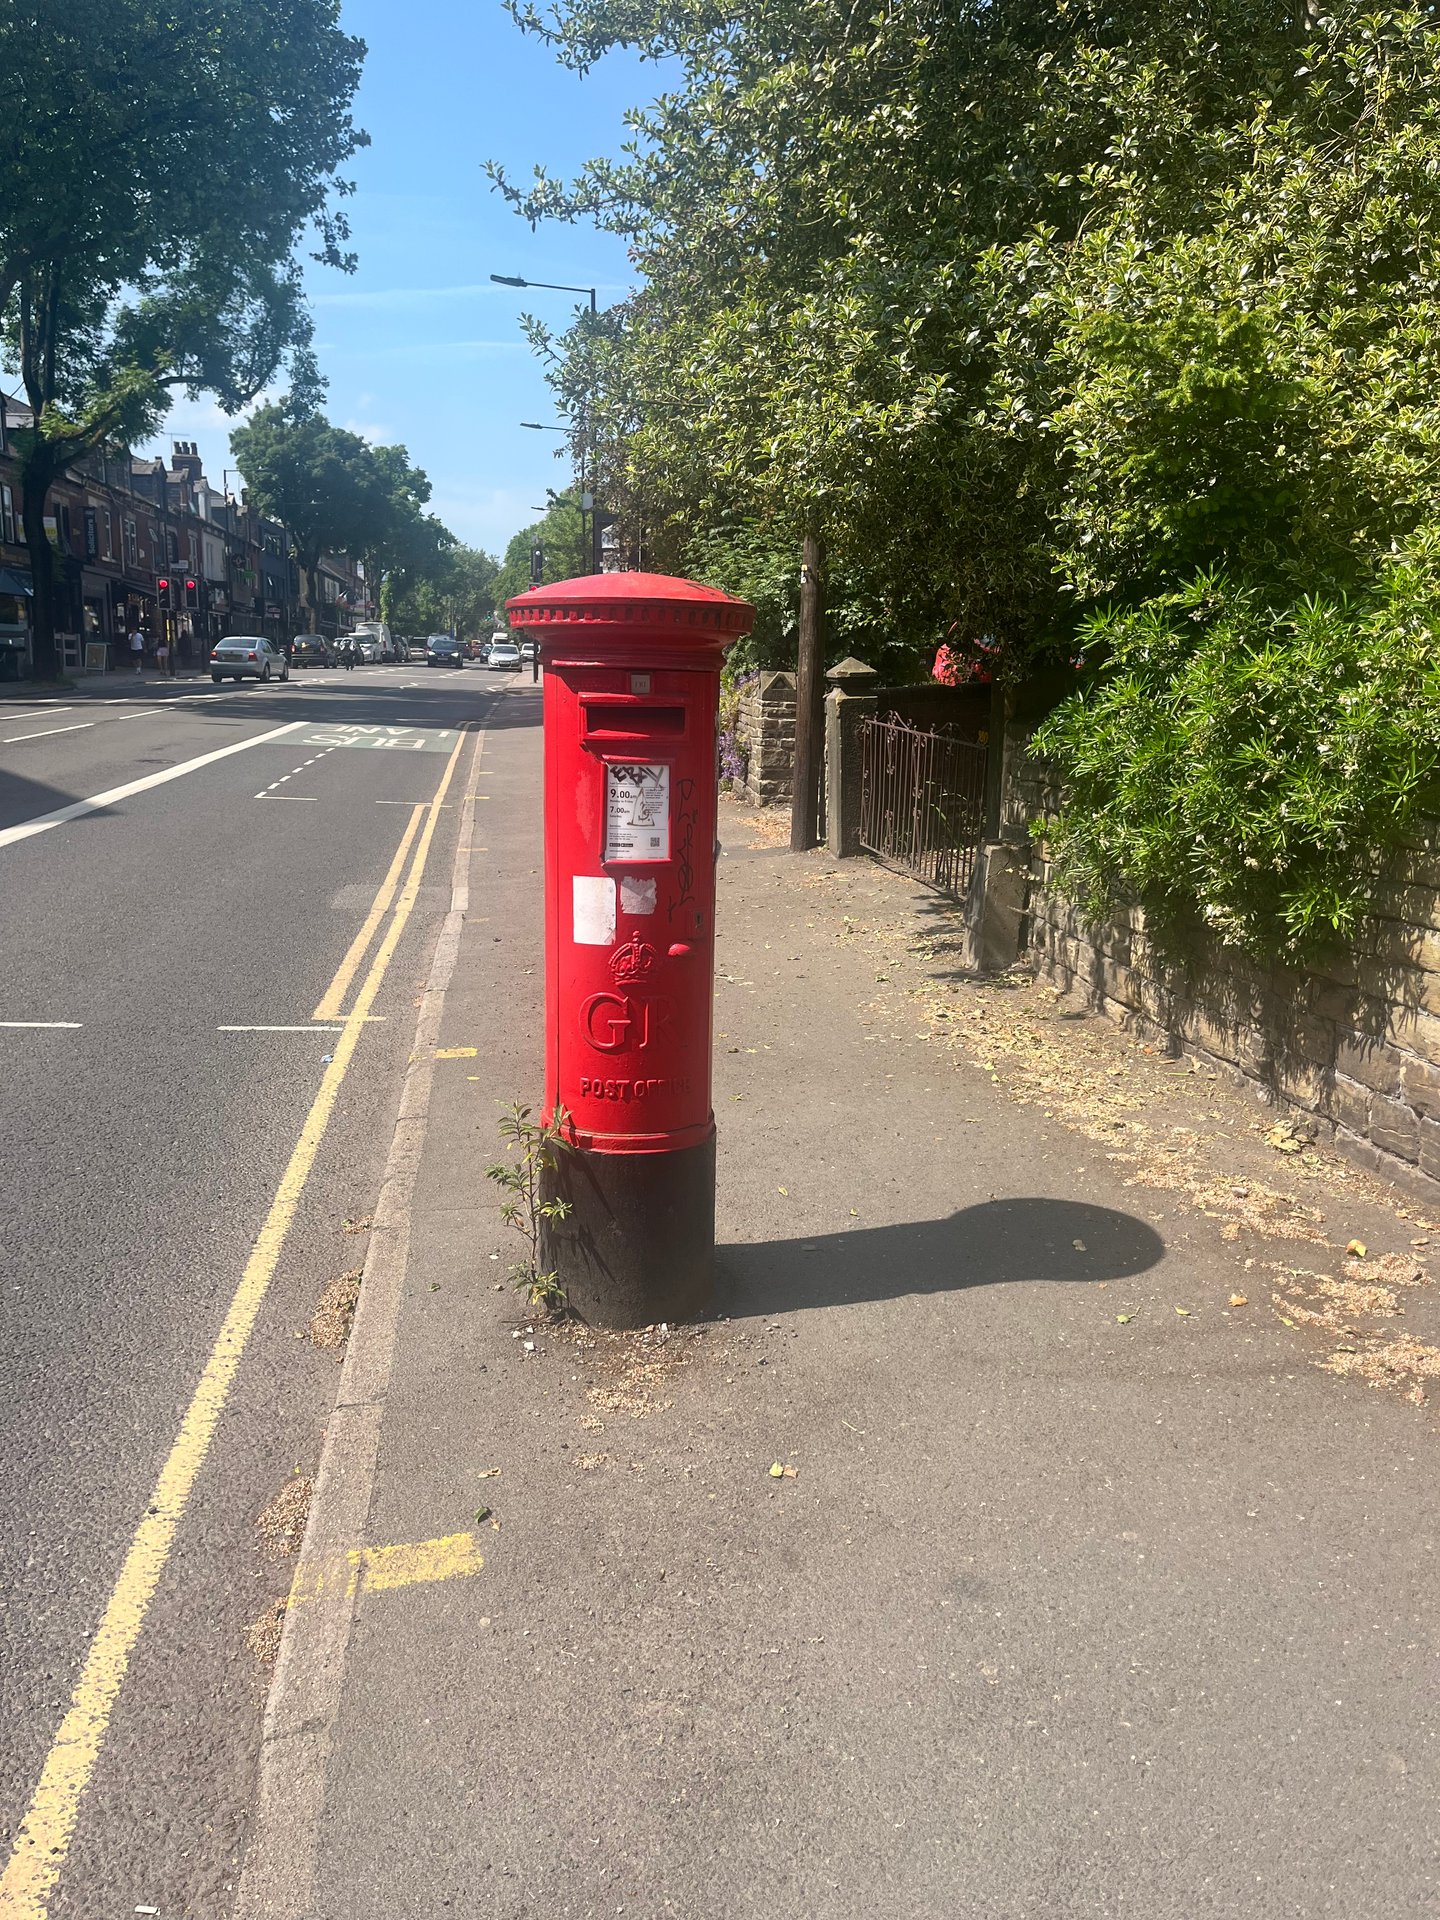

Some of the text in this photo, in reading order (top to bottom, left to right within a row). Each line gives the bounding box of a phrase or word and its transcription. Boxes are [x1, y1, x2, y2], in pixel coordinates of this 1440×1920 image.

[87, 518, 96, 555] Solicitors
[303, 734, 426, 749] BUS
[308, 725, 451, 738] LANE
[580, 1076, 632, 1101] POST
